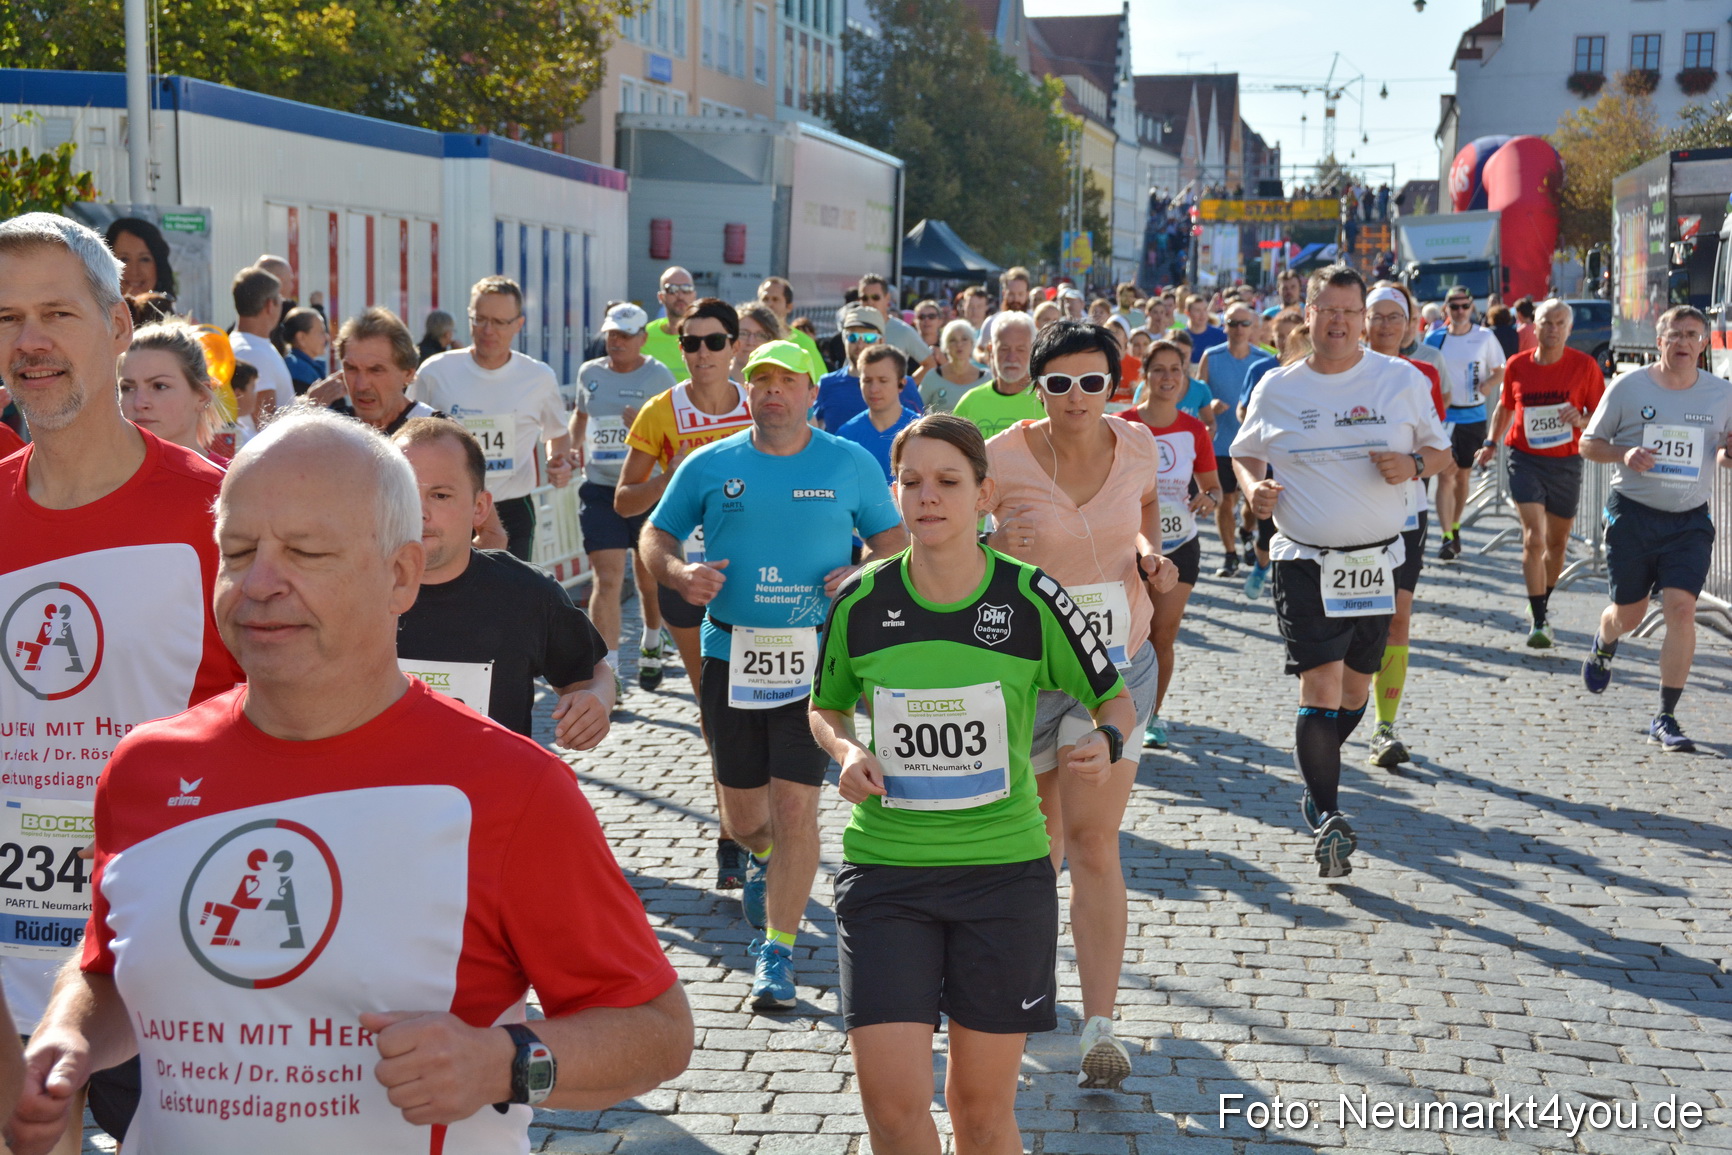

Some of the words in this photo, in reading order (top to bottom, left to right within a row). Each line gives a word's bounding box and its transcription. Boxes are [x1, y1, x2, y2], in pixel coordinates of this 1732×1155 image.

[473, 431, 505, 450] 14
[593, 429, 627, 444] 2578
[1652, 440, 1693, 458] 2151
[487, 461, 506, 471] AN
[1661, 465, 1682, 474] Erwin
[793, 489, 836, 500] BOCK
[722, 501, 744, 509] PARTL
[1161, 516, 1182, 533] 38
[759, 566, 783, 583] 18.
[1333, 567, 1384, 589] 2104
[755, 583, 813, 593] Neumarkter
[754, 595, 802, 605] Stadtlauf
[1070, 593, 1104, 605] OCK
[1343, 600, 1373, 609] Jürgen
[882, 620, 905, 628] erima
[977, 625, 1008, 636] Daßwang
[755, 635, 794, 645] BOCK
[743, 650, 805, 675] 2515
[753, 689, 794, 700] Michael
[907, 699, 966, 712] BOCK
[0, 721, 35, 737] UFEN
[46, 721, 85, 737] MIT
[95, 716, 138, 738] HER
[893, 720, 987, 758] 3003
[55, 748, 76, 760] Dr.
[904, 764, 931, 772] PARTL
[933, 763, 971, 771] Neumarkt
[167, 793, 202, 807] erima
[21, 813, 95, 832] BOCK
[0, 842, 93, 893] 234
[5, 897, 39, 909] PARTL
[42, 900, 93, 912] Neumarkt
[15, 919, 85, 947] Rüdige
[137, 1010, 224, 1043] LAUFEN
[240, 1023, 292, 1046] MIT
[309, 1017, 374, 1047] HER
[157, 1059, 176, 1078] Dr.
[182, 1061, 229, 1080] Heck
[234, 1061, 243, 1085] /
[250, 1064, 278, 1083] Dr.
[286, 1064, 362, 1084] Röschl
[160, 1089, 361, 1123] Leistungsdiagnostik
